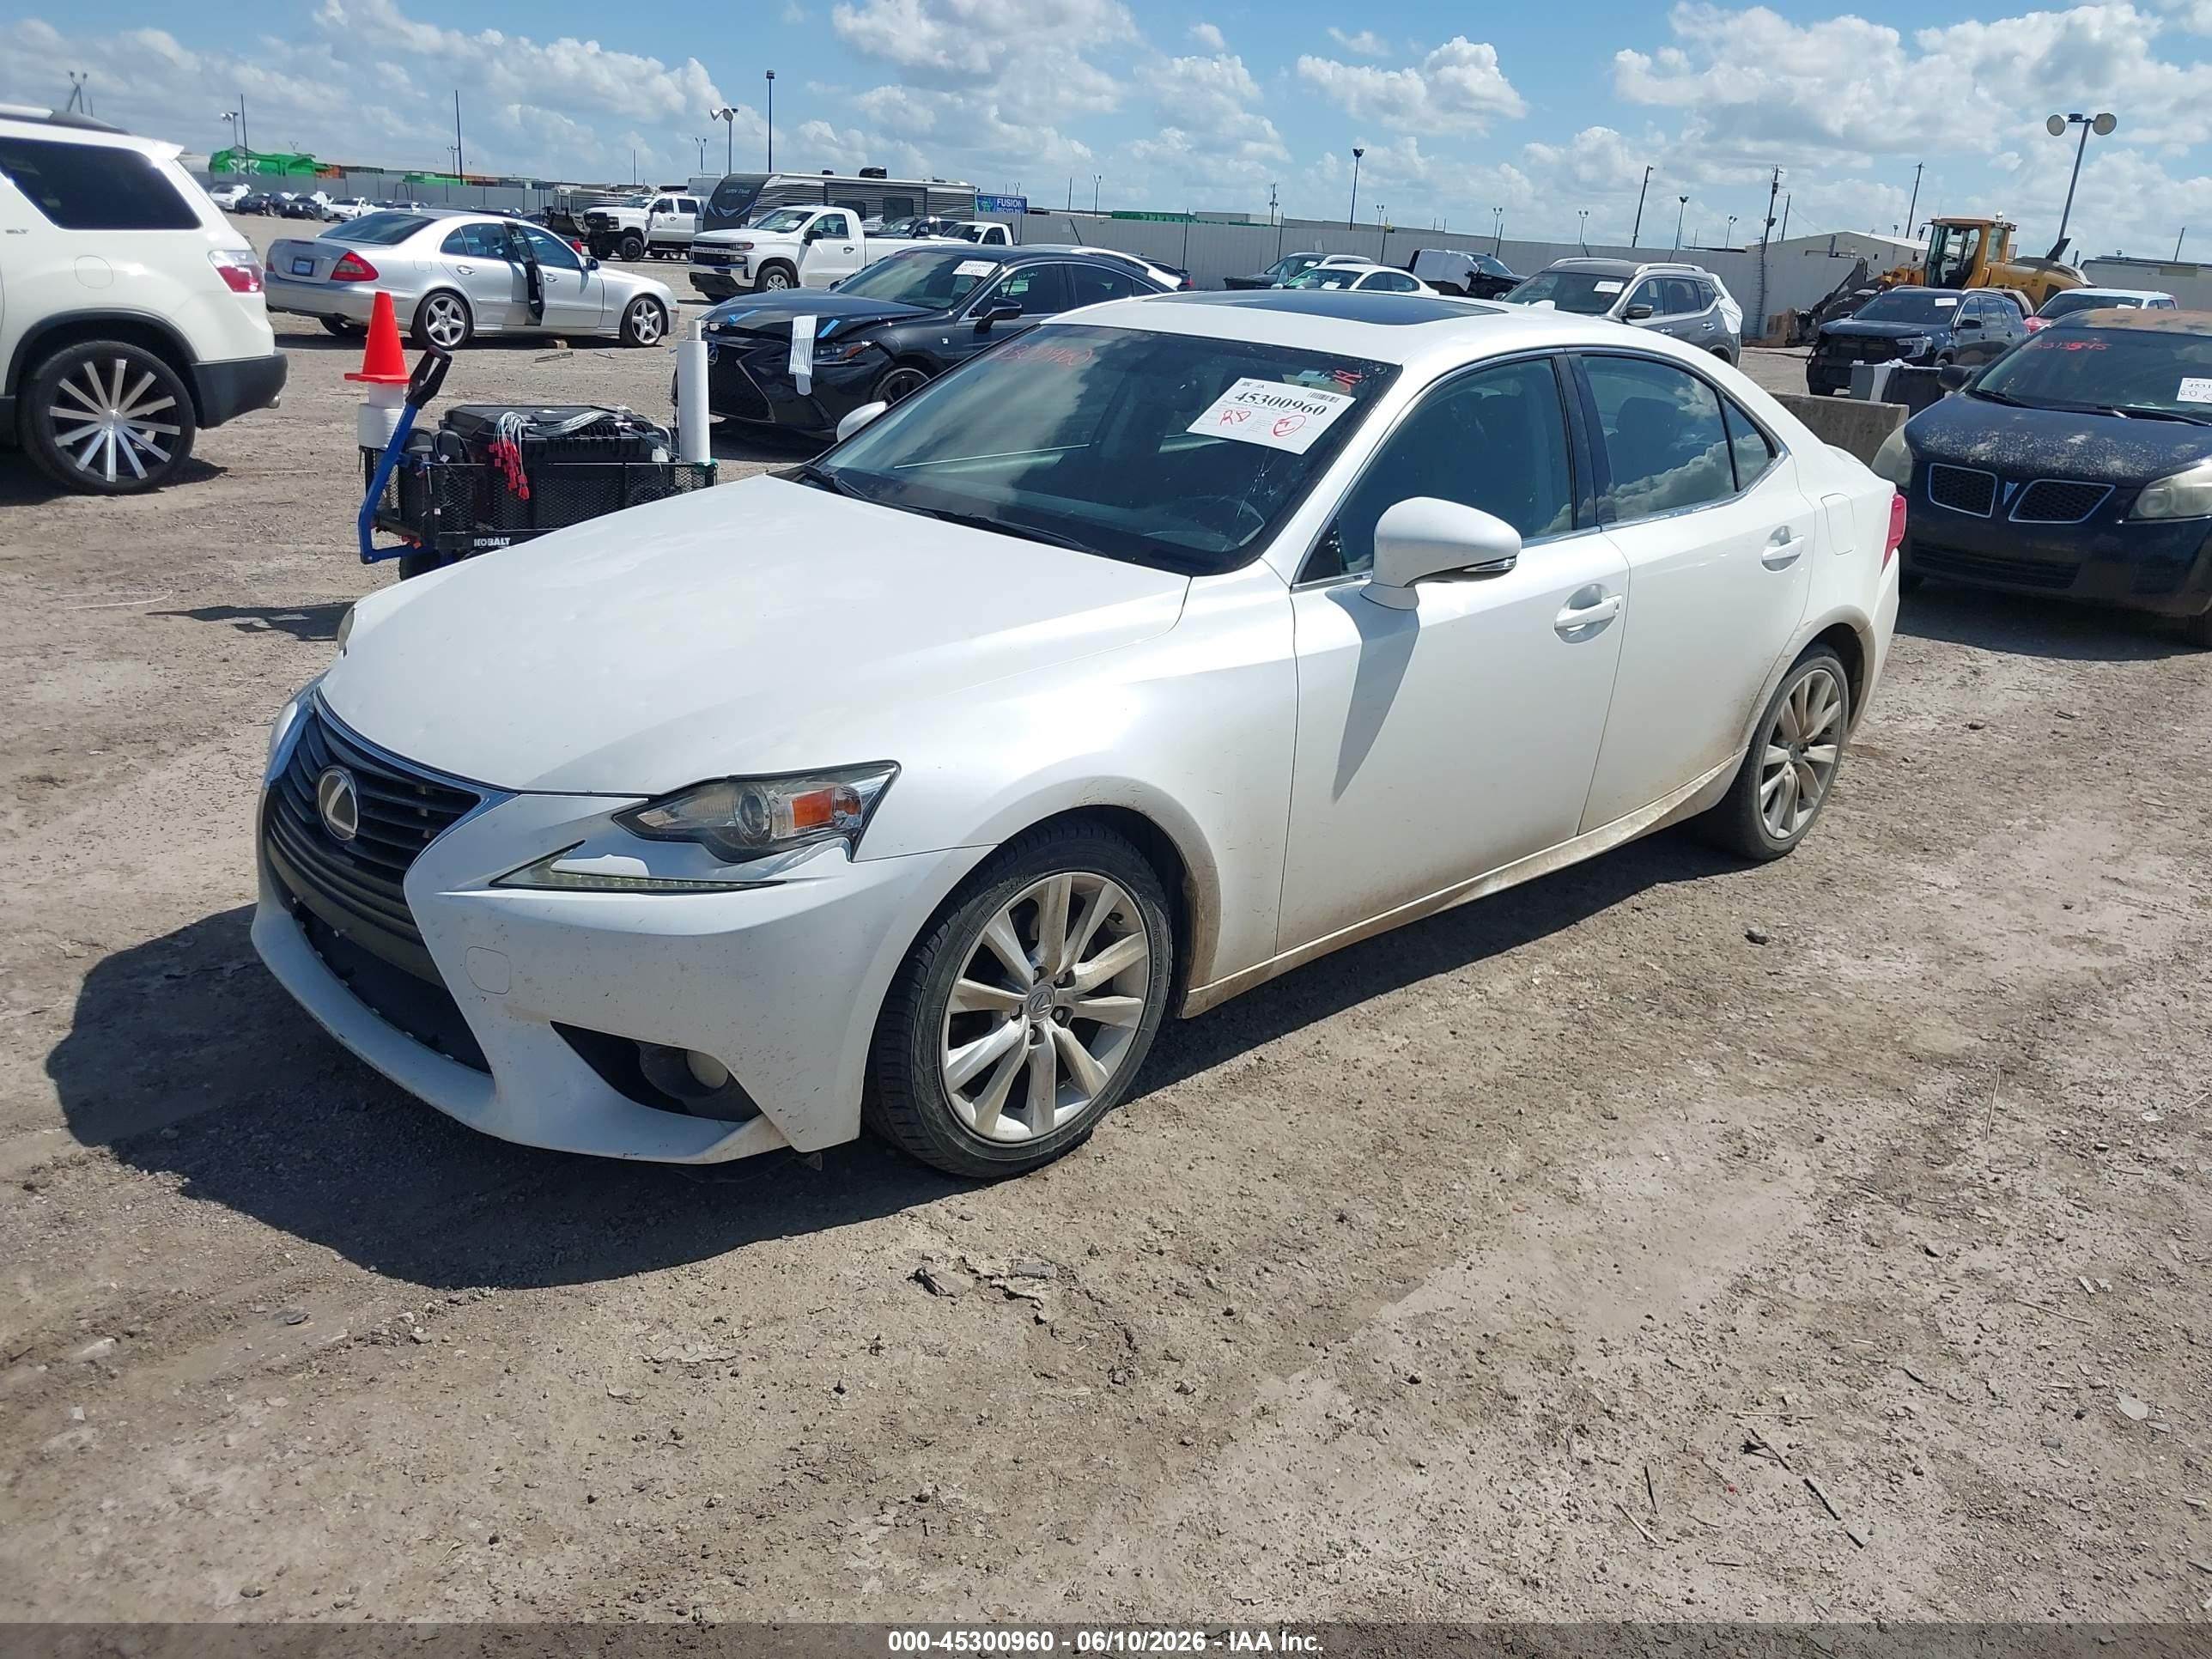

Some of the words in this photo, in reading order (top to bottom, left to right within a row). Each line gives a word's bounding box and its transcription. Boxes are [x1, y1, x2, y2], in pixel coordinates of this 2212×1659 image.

[996, 198, 1023, 208] FUSION
[1234, 392, 1328, 416] 45300960
[473, 537, 511, 547] KOBALT
